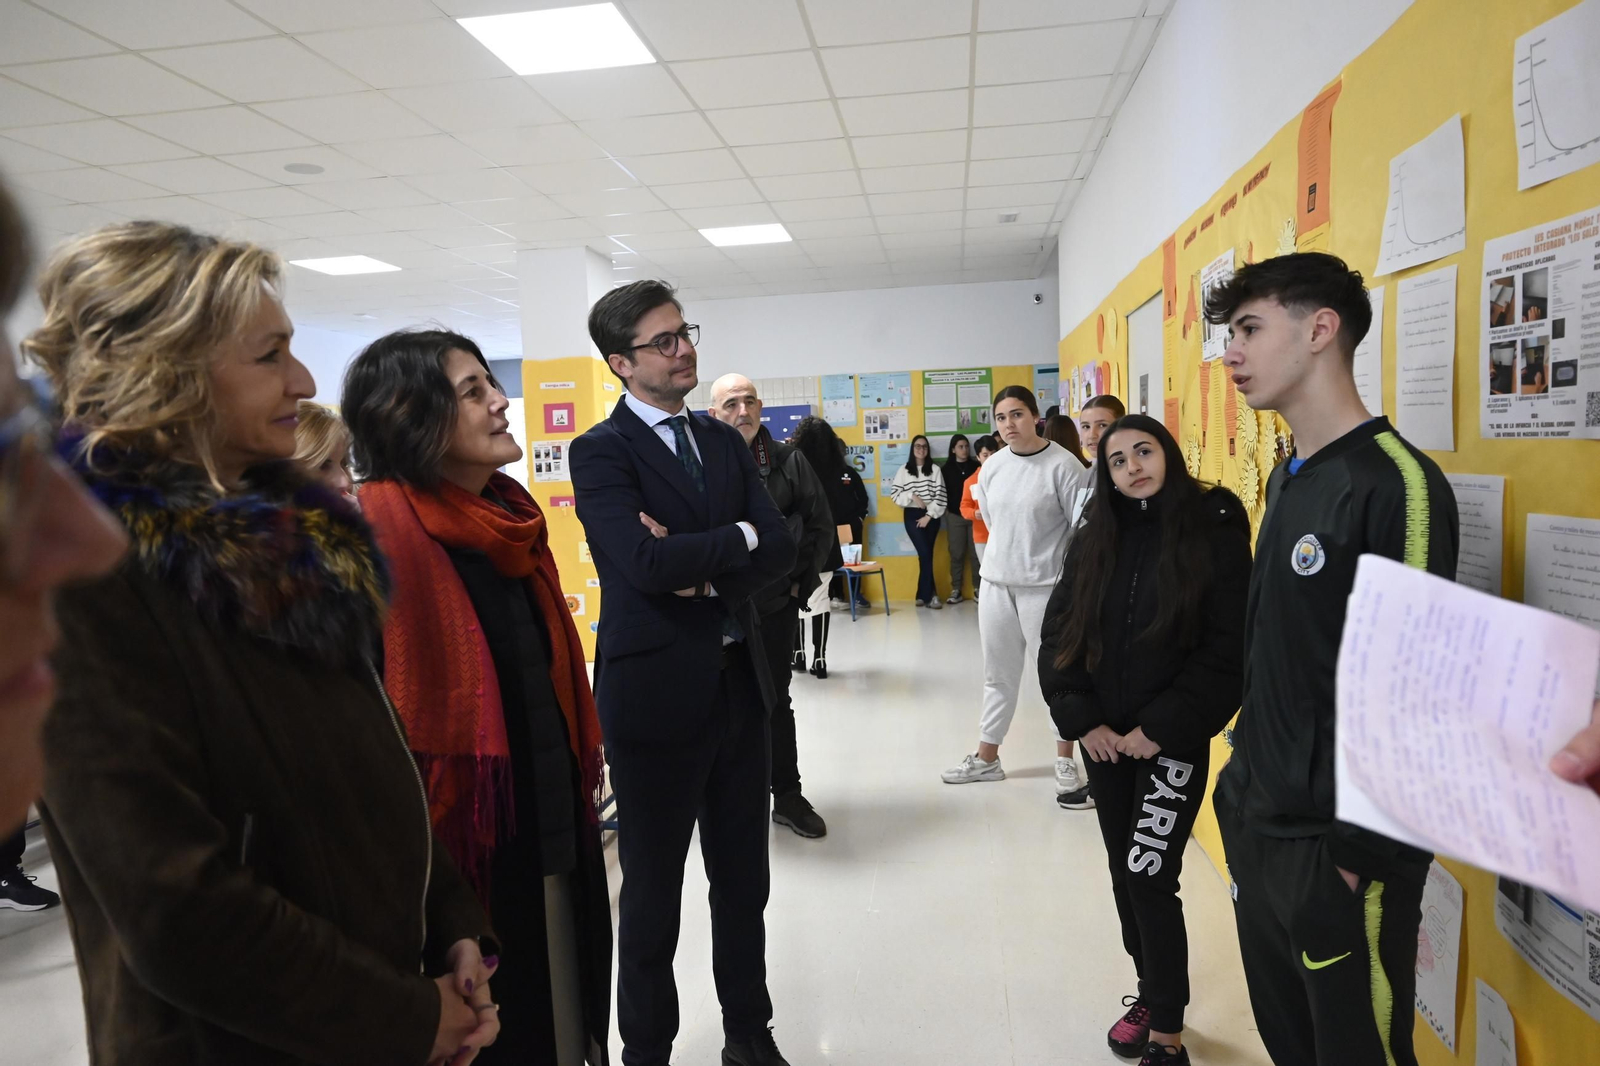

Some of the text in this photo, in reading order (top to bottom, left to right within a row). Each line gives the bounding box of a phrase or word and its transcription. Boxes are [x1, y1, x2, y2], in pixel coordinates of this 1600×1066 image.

[1502, 247, 1531, 262] PROYECTO
[1534, 237, 1565, 254] INTEGRADO
[1535, 255, 1556, 265] APLICADAS
